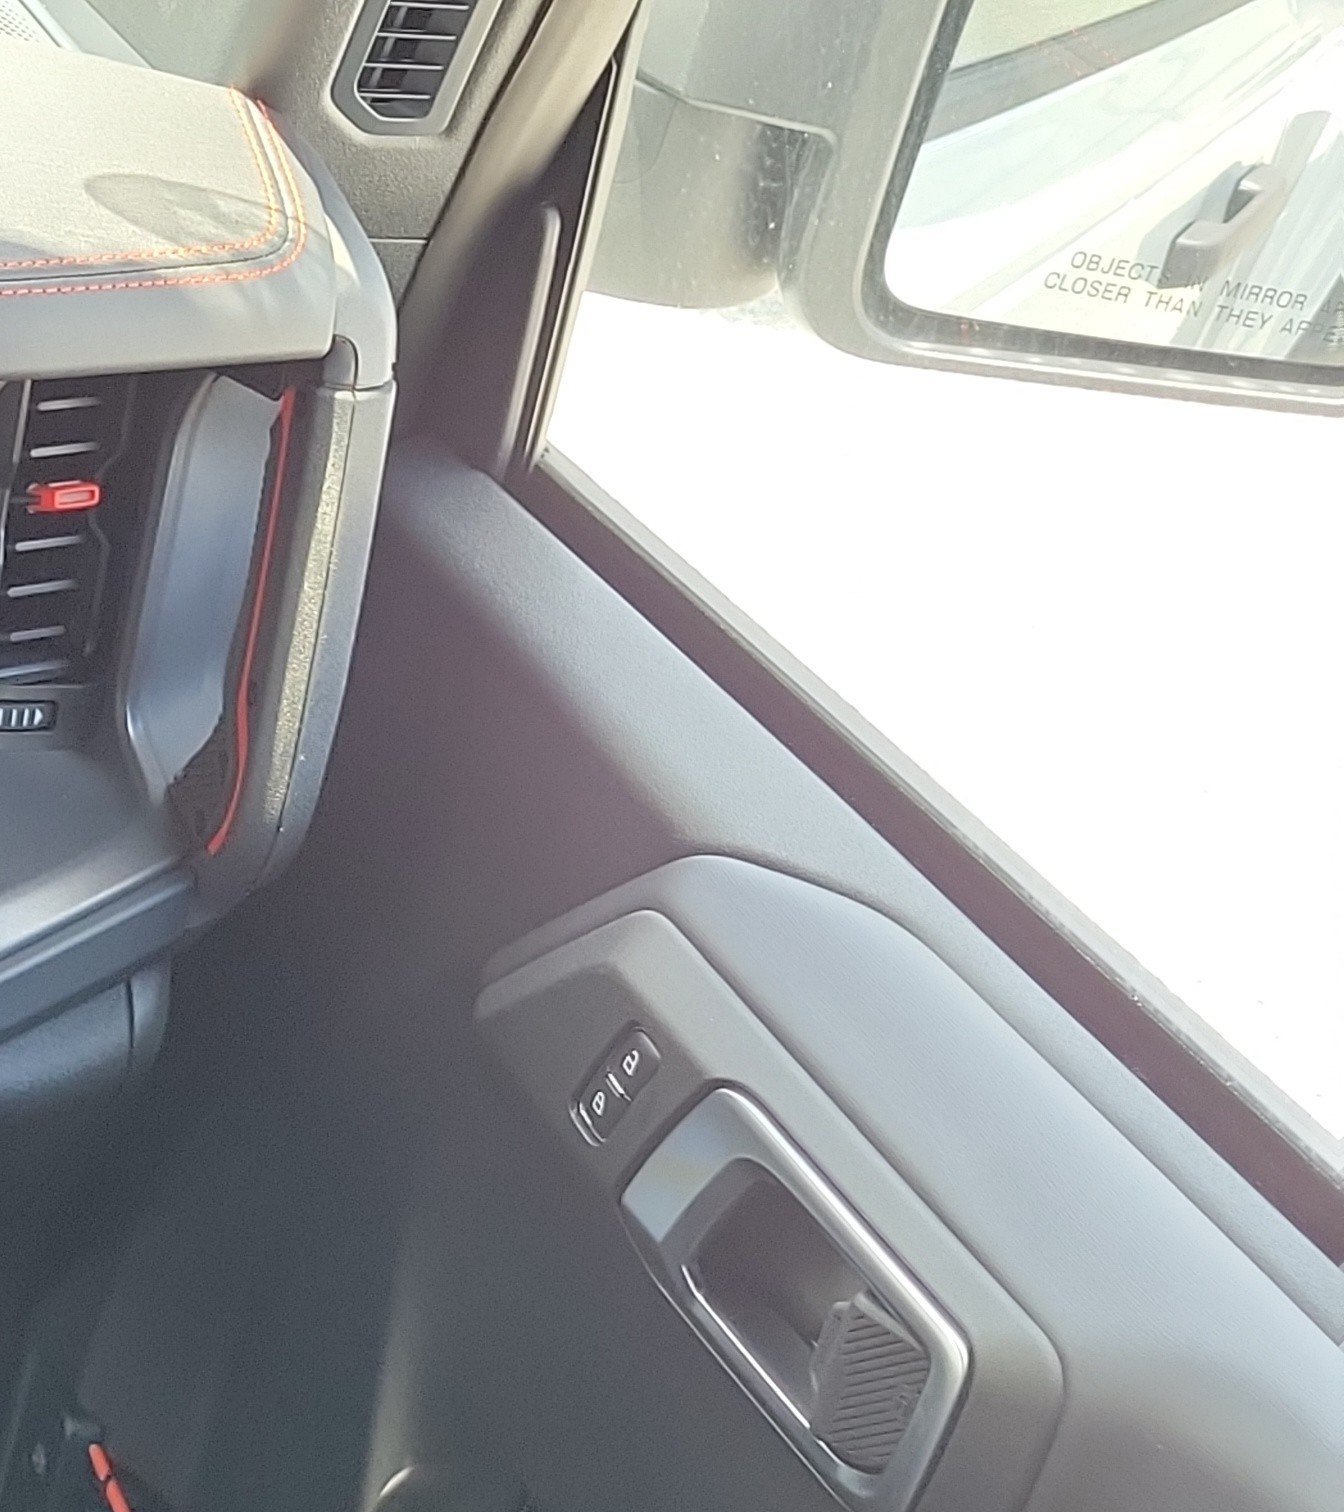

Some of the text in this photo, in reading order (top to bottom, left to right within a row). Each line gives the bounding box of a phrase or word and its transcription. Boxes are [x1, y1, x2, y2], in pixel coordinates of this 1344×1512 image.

[1044, 271, 1131, 304] CLOSER
[1144, 290, 1203, 317] THAN
[1215, 304, 1273, 330] THEY
[1219, 280, 1308, 311] MIRROR
